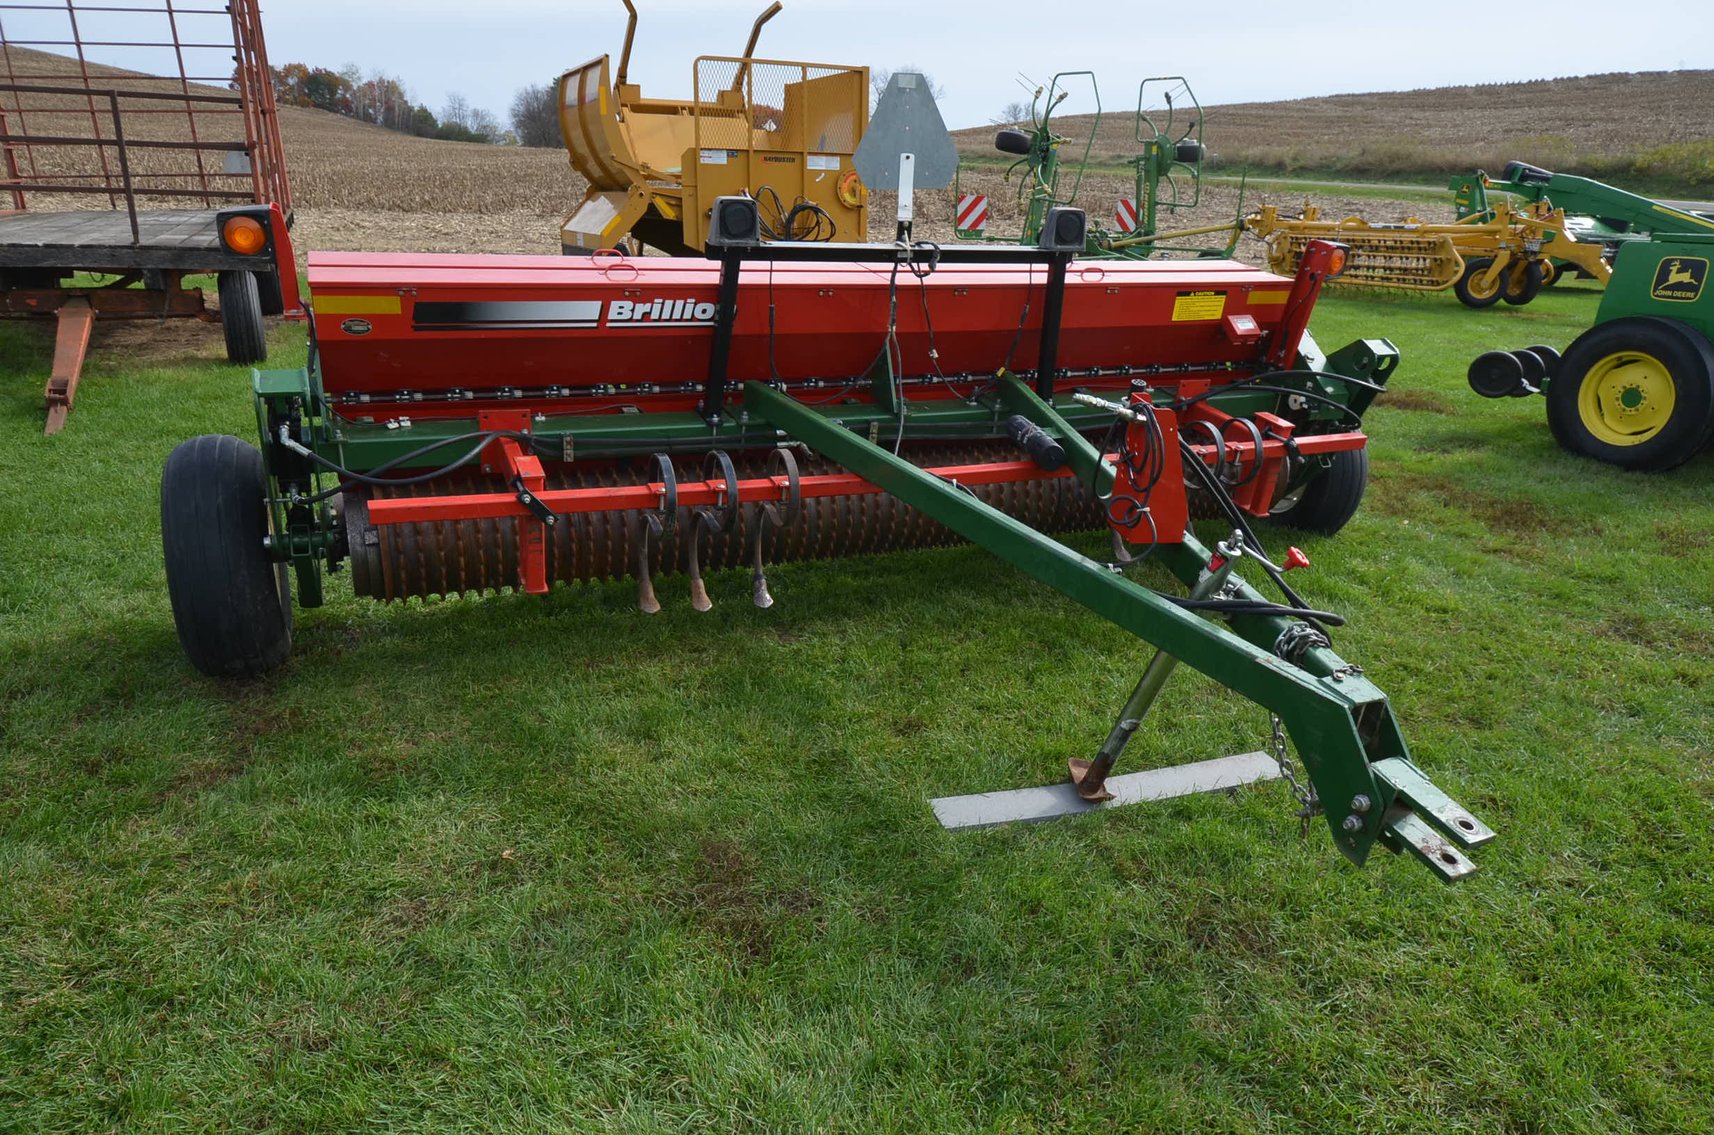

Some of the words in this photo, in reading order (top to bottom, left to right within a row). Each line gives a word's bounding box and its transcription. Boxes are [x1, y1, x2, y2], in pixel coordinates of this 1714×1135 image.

[1654, 289, 1673, 297] JOHN
[1673, 290, 1696, 298] DEERE
[607, 298, 736, 320] Brillio
